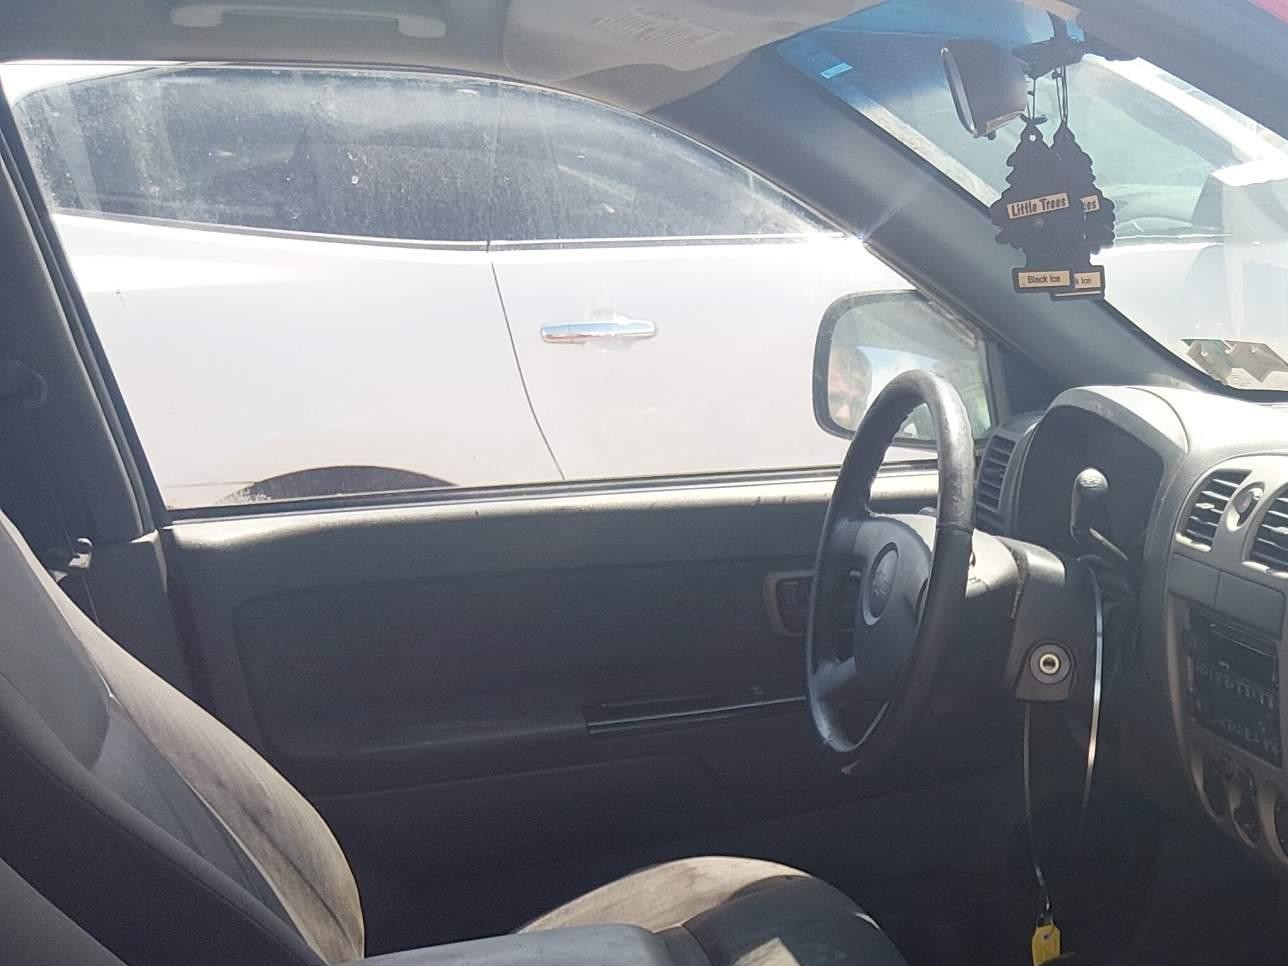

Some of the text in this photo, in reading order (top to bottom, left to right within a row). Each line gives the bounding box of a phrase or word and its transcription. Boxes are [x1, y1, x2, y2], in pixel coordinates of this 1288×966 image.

[1011, 198, 1066, 217] Little Trees
[1027, 274, 1049, 284] Black
